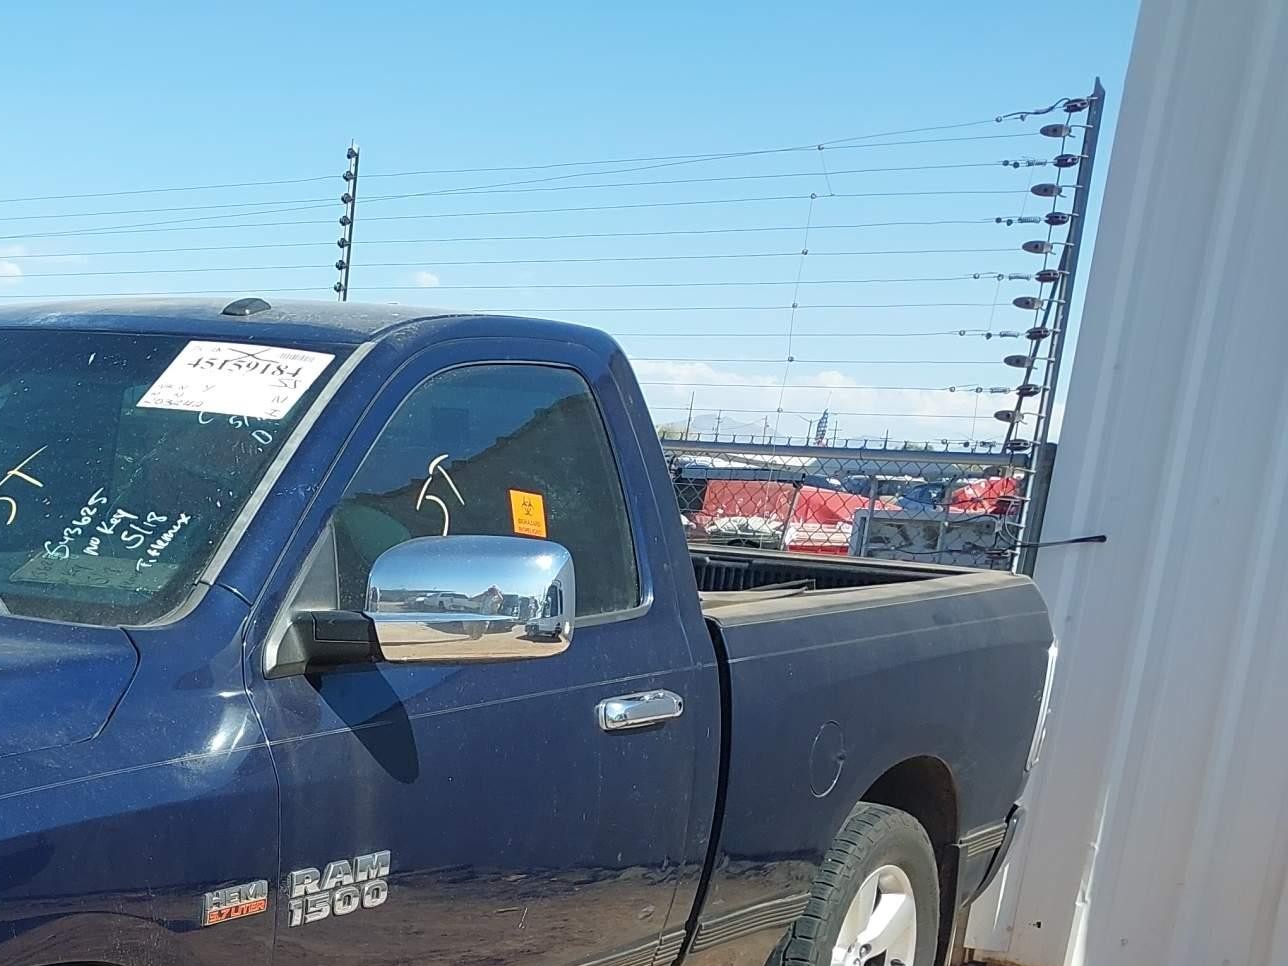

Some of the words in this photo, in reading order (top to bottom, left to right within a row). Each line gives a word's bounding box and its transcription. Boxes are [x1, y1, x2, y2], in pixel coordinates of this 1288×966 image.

[187, 356, 302, 378] 45159184
[288, 850, 391, 898] RAM
[205, 880, 269, 909] HEMI
[288, 879, 389, 928] 1500
[209, 907, 228, 923] 5.7
[231, 900, 266, 919] LITER
